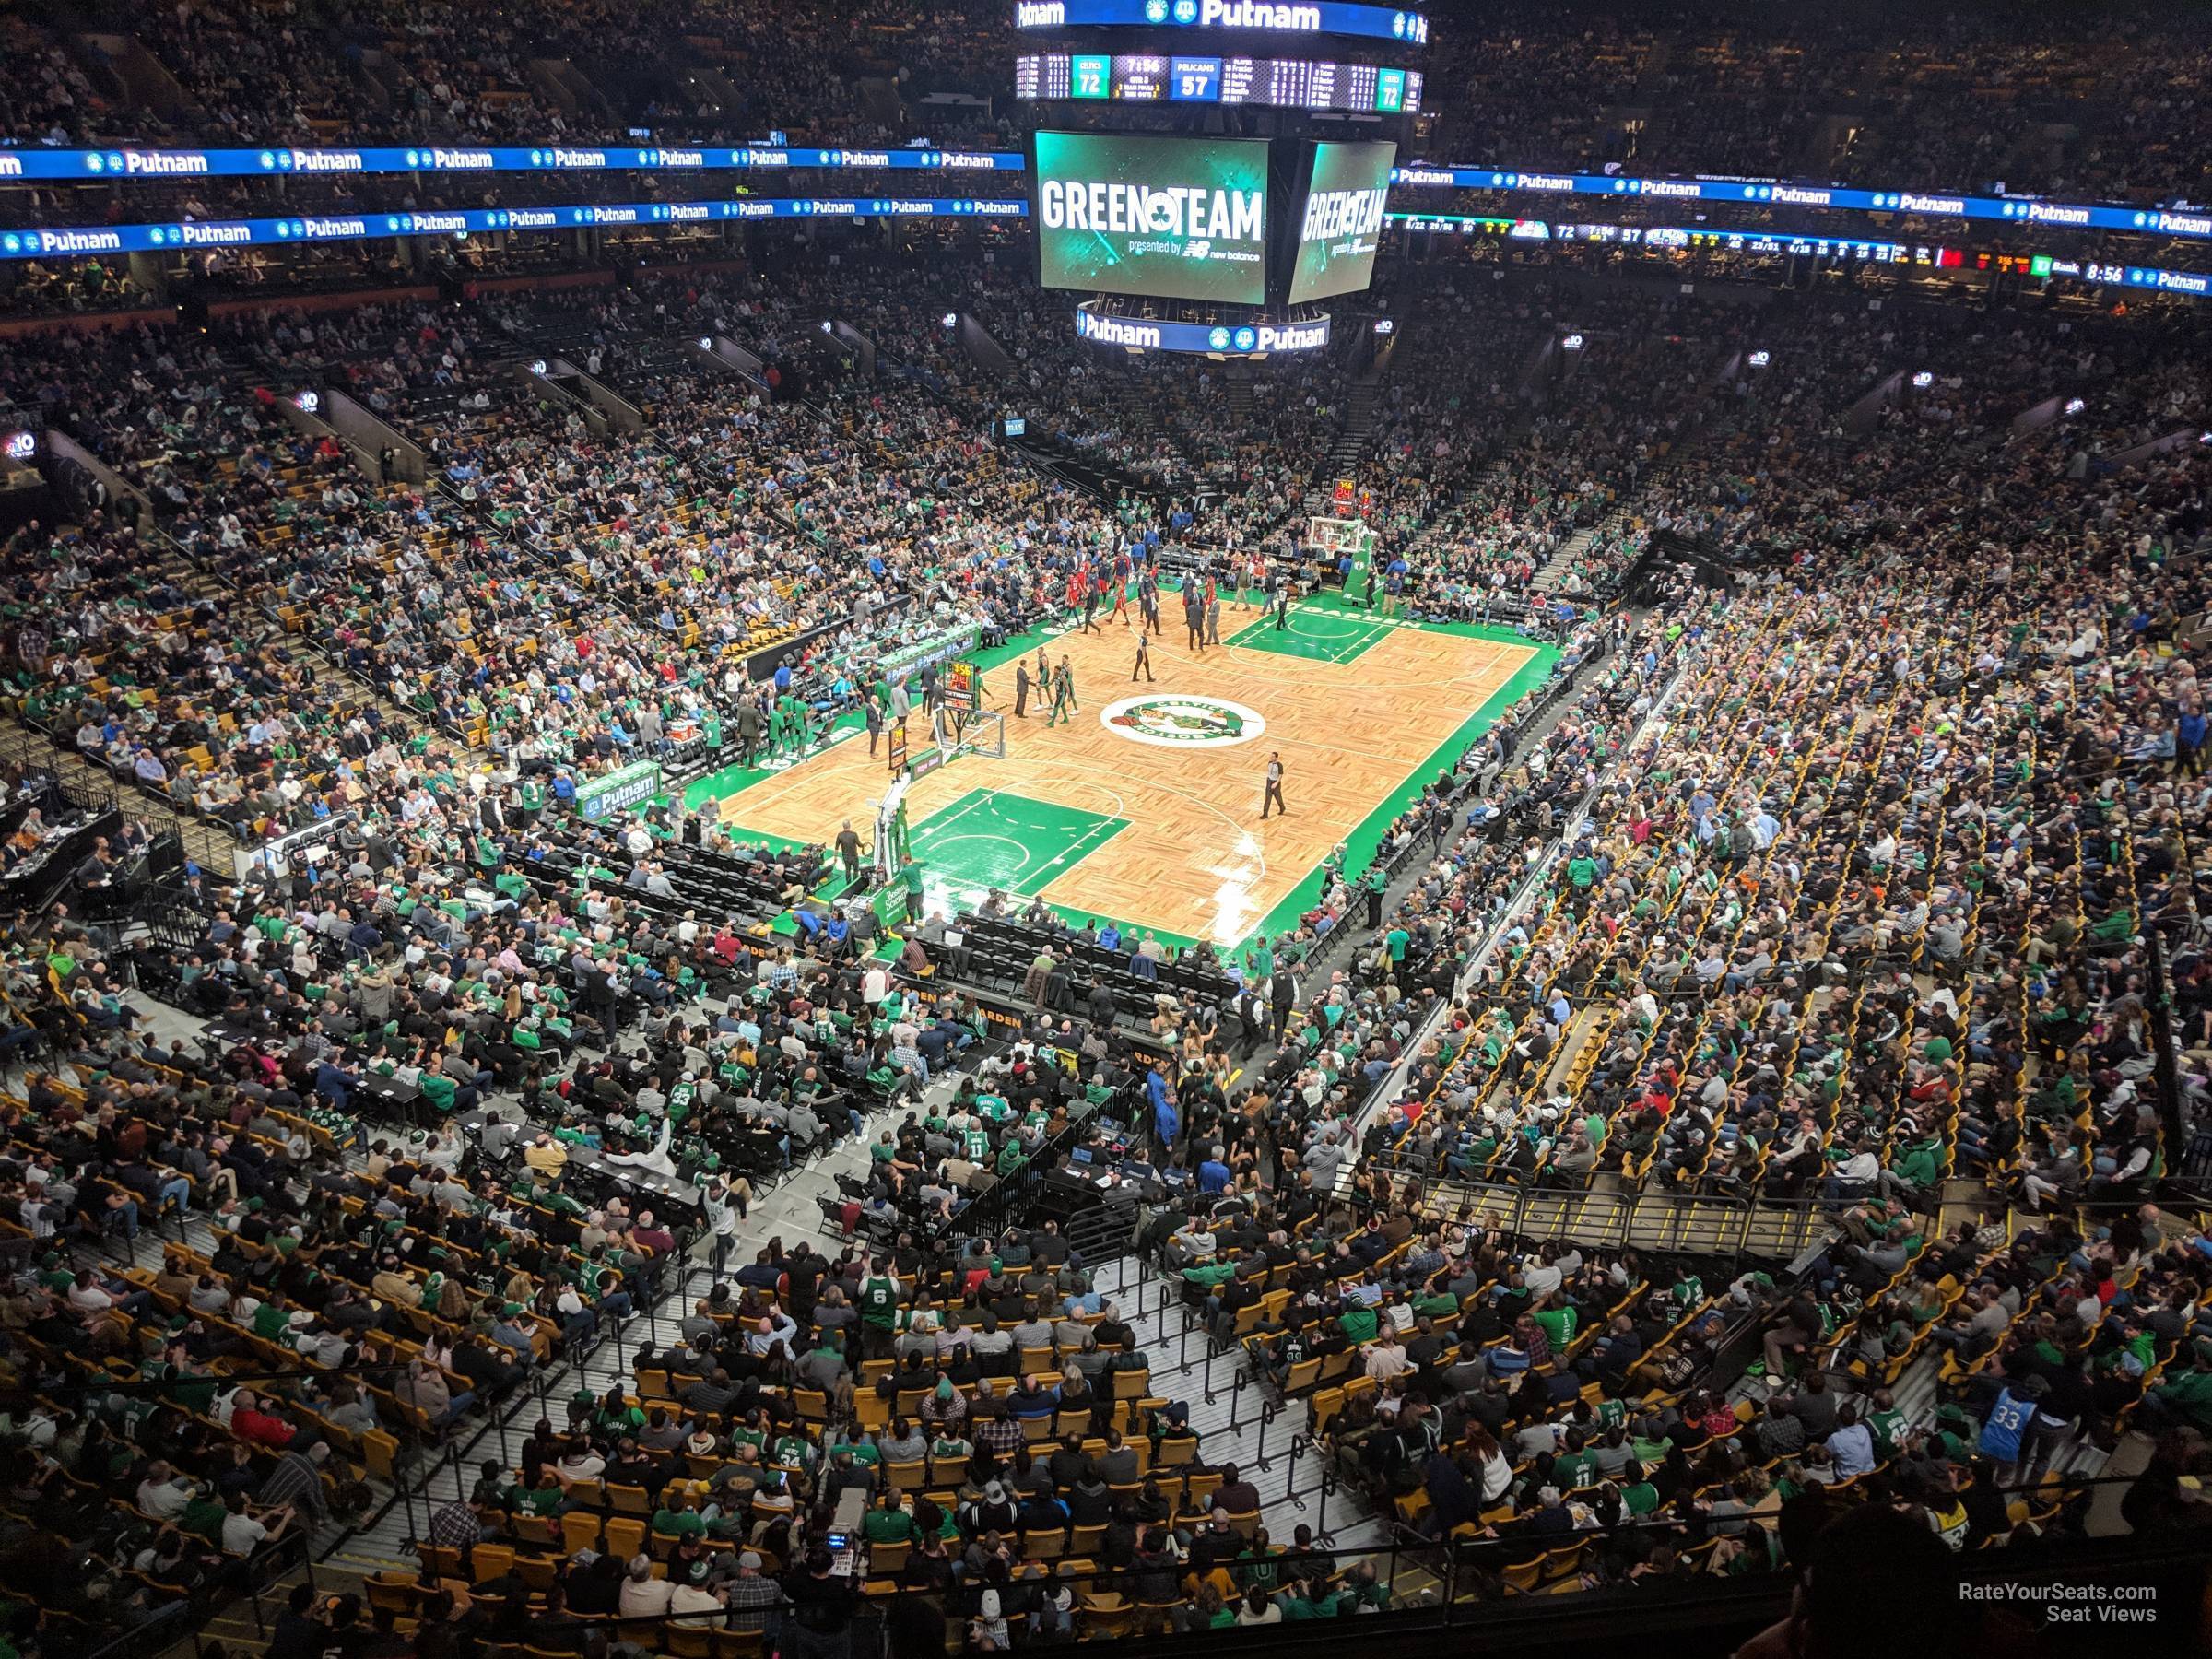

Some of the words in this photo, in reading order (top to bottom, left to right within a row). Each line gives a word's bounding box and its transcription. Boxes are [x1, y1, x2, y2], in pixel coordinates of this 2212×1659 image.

[1202, 0, 1319, 29] Putnam
[1127, 59, 1159, 73] 7:56
[1178, 64, 1215, 72] PELICANS
[1080, 75, 1100, 92] 72
[1182, 76, 1207, 96] 57
[127, 152, 207, 174] Putnam
[295, 150, 361, 171] Putnam
[435, 150, 492, 169] Putnam
[555, 149, 606, 167] Putnam
[659, 150, 702, 166] Putnam
[749, 150, 787, 165] Putnam
[842, 151, 888, 166] Putnam
[942, 153, 994, 168] Putnam
[1399, 169, 1453, 184] Putnam
[1518, 175, 1573, 191] Putnam
[1641, 181, 1700, 197] Putnam
[1771, 187, 1830, 205] Putnam
[670, 205, 708, 219] Putnam
[739, 202, 773, 216] Putnam
[813, 201, 855, 214] Putnam
[891, 200, 932, 213] Putnam
[974, 202, 1019, 215] Putnam
[1042, 180, 1147, 233] GREEN
[1167, 188, 1262, 241] TEAM
[1900, 195, 1963, 214] Putnam
[510, 211, 555, 226] Putnam
[594, 207, 636, 222] Putnam
[1303, 192, 1348, 241] GREEN
[1352, 189, 1387, 232] TEAM
[2029, 204, 2088, 223] Putnam
[306, 220, 364, 238] Putnam
[413, 215, 465, 231] Putnam
[2159, 214, 2211, 233] Putnam
[43, 231, 120, 252] Putnam
[183, 224, 251, 243] Putnam
[1558, 226, 1574, 238] 72
[1589, 226, 1614, 235] 7:56
[1622, 229, 1641, 241] 57
[1129, 240, 1170, 253] presented
[1172, 243, 1181, 254] by
[1210, 252, 1226, 260] new
[1228, 251, 1259, 262] balance
[2053, 262, 2079, 274] Bank
[2088, 265, 2122, 281] 8:56
[2158, 272, 2206, 291] Putnam
[1085, 316, 1159, 347] Putnam
[1259, 326, 1324, 350] Putnam
[15, 435, 34, 451] 10
[1336, 488, 1350, 499] 24
[1302, 606, 1422, 628] GARDEN
[1157, 701, 1229, 713] CELTICS
[602, 776, 654, 808] Putnam
[977, 1008, 1022, 1029] ARDEN
[673, 1092, 690, 1106] 33
[971, 1145, 982, 1158] 11
[359, 1231, 372, 1247] 11
[874, 1288, 887, 1304] 6
[1668, 1312, 1677, 1325] 5
[1287, 1351, 1301, 1361] 11
[1994, 1406, 2020, 1430] 33
[780, 1454, 800, 1467] 34
[1576, 1473, 1589, 1487] 11
